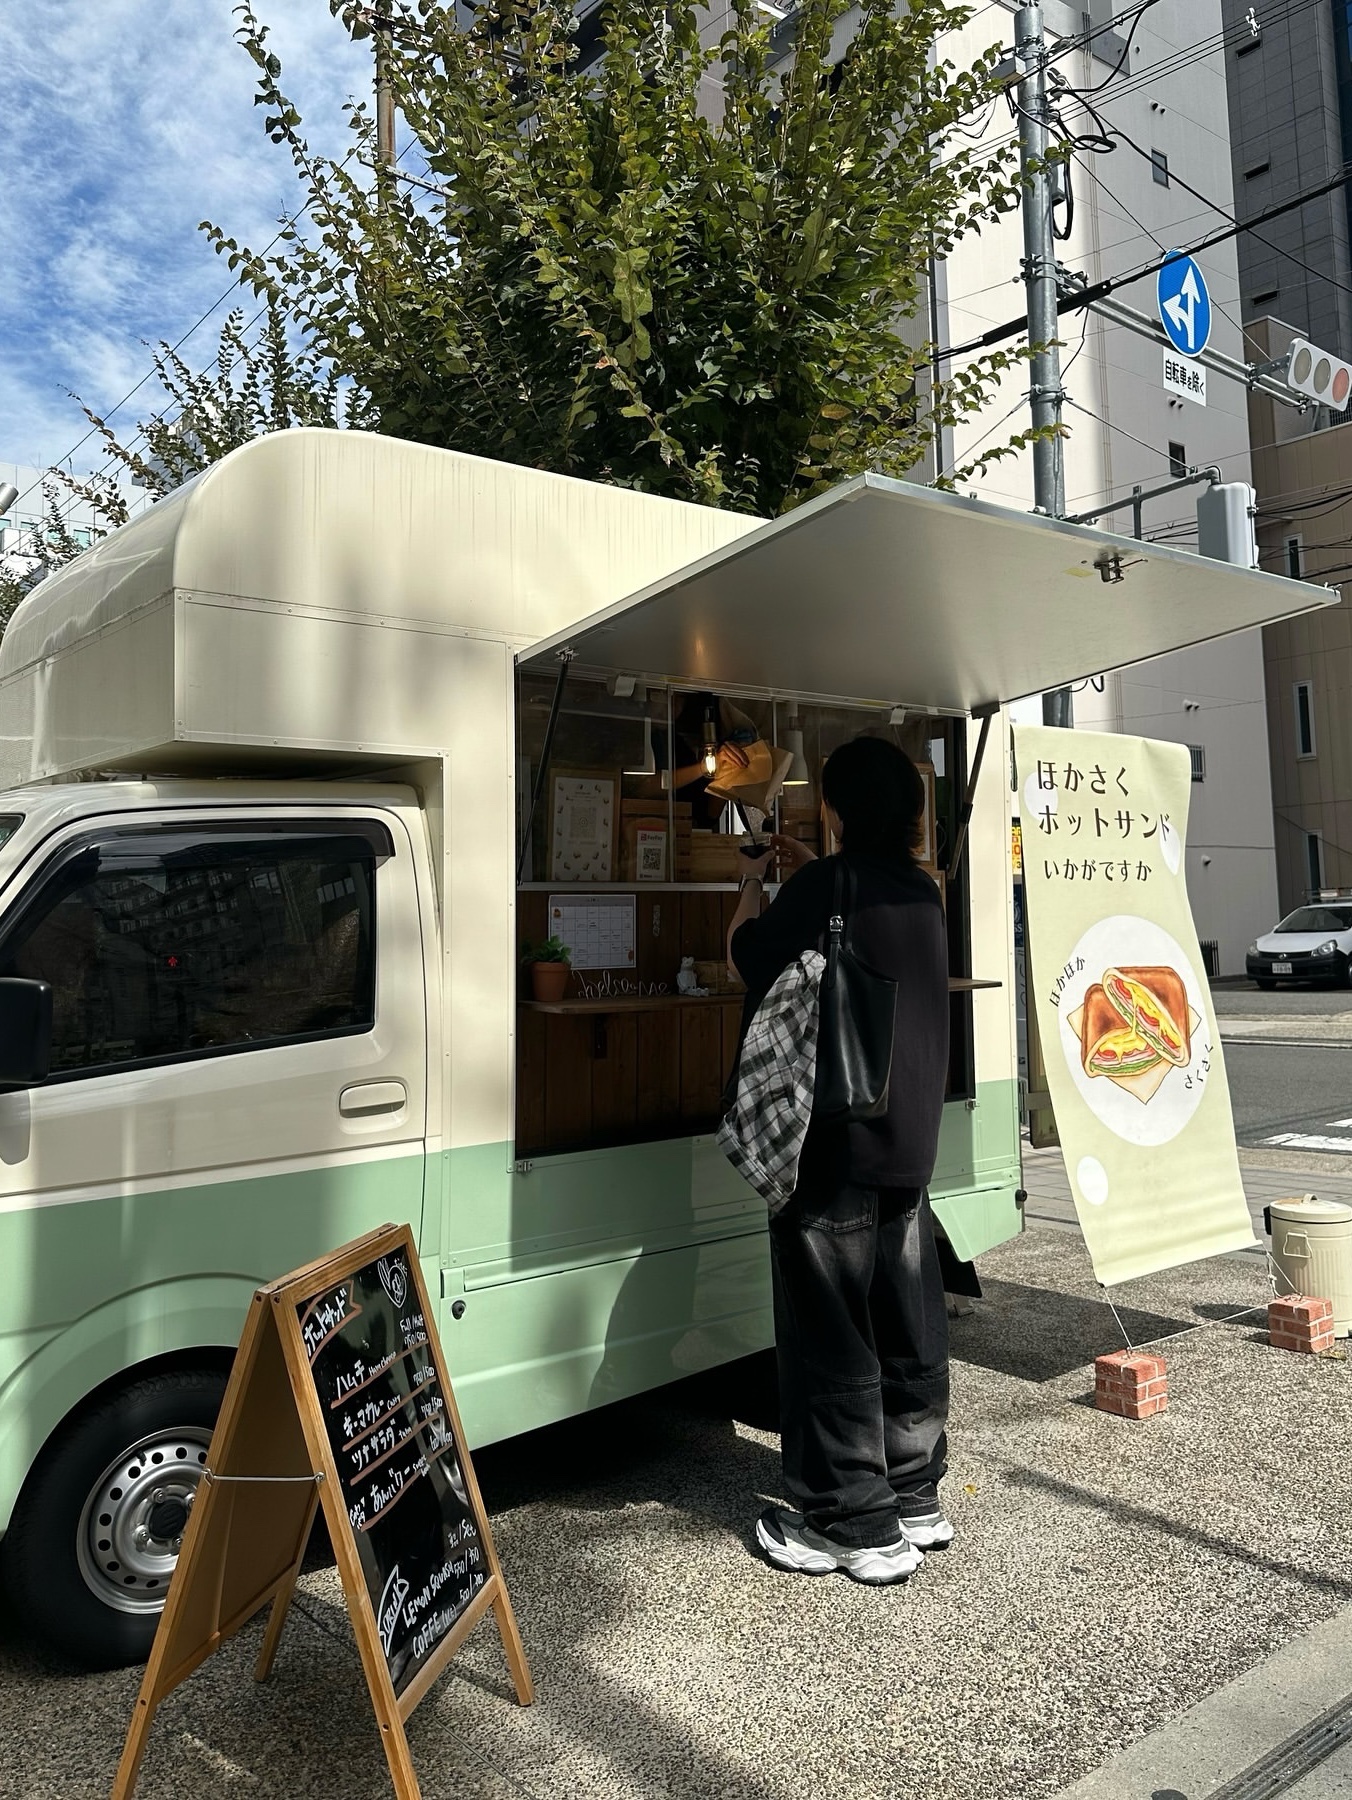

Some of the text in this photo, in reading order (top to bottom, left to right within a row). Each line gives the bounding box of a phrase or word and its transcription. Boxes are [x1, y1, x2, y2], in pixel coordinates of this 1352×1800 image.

[1165, 359, 1204, 396] 自転車を除く
[1037, 760, 1129, 797] ほかさく
[1038, 805, 1170, 842] ホットサンド
[1044, 858, 1152, 883] いかがですか
[1049, 956, 1086, 1008] ほかほか
[1184, 1044, 1214, 1089] さくさく
[304, 1287, 347, 1358] ホットサンド
[402, 1585, 431, 1628] LEMON
